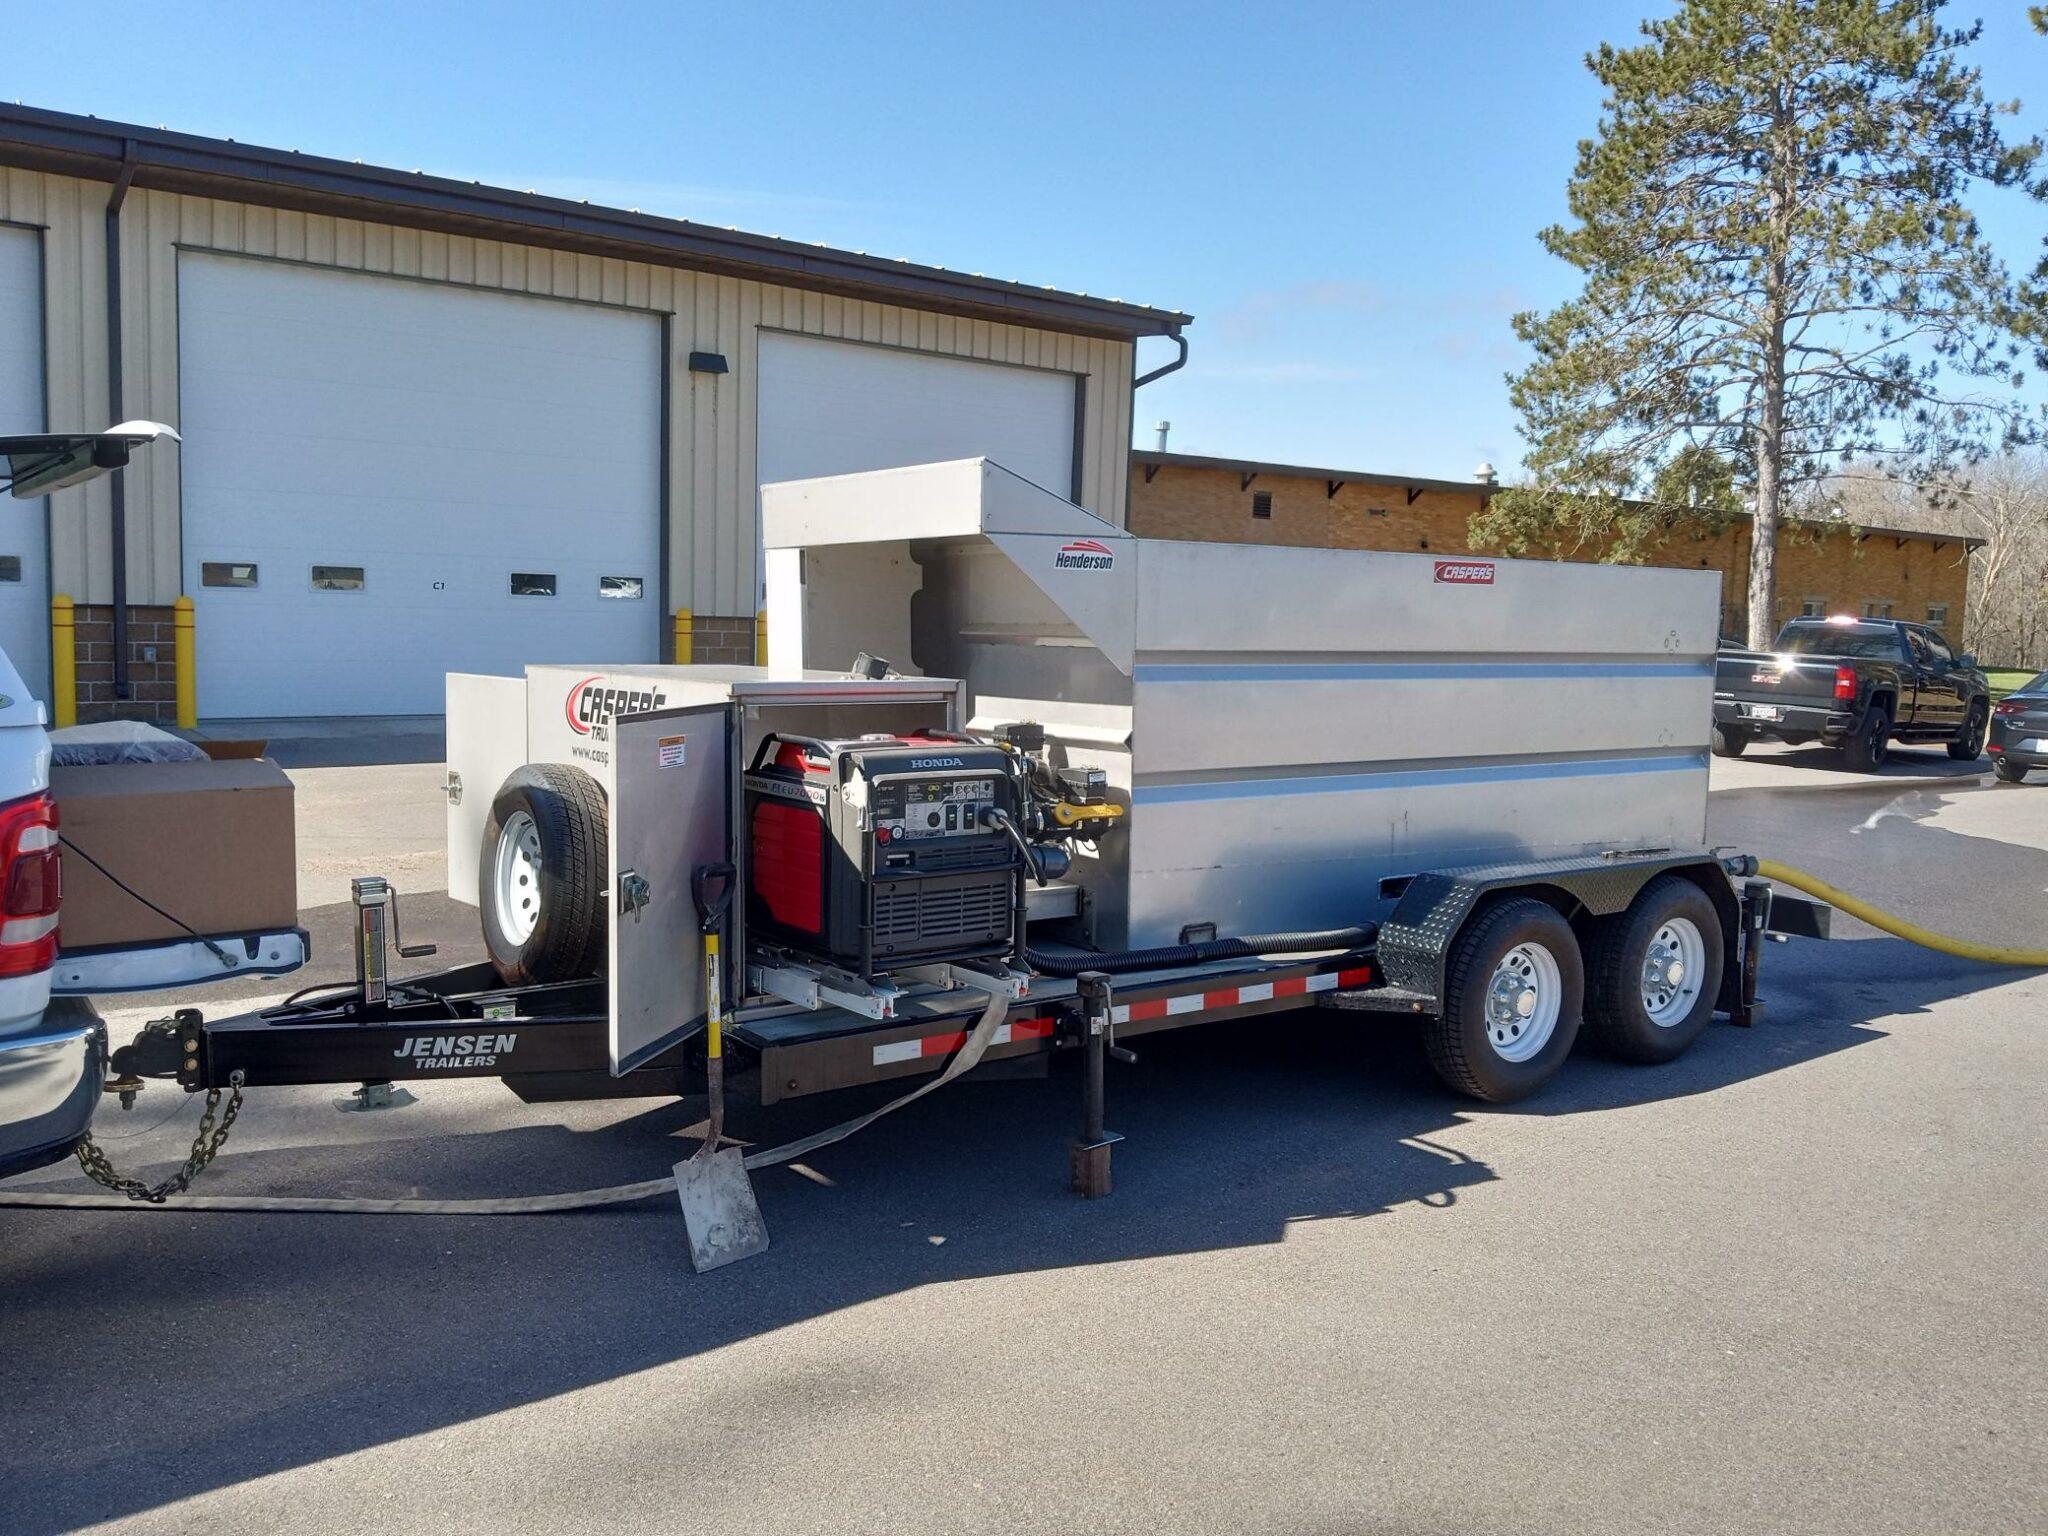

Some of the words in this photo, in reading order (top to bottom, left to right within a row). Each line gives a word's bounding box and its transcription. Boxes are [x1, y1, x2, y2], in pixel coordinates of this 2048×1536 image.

[1055, 552, 1113, 569] Henderson
[911, 758, 964, 769] HONDA
[393, 1034, 517, 1058] JENSEN
[415, 1055, 497, 1069] TRAILERS
